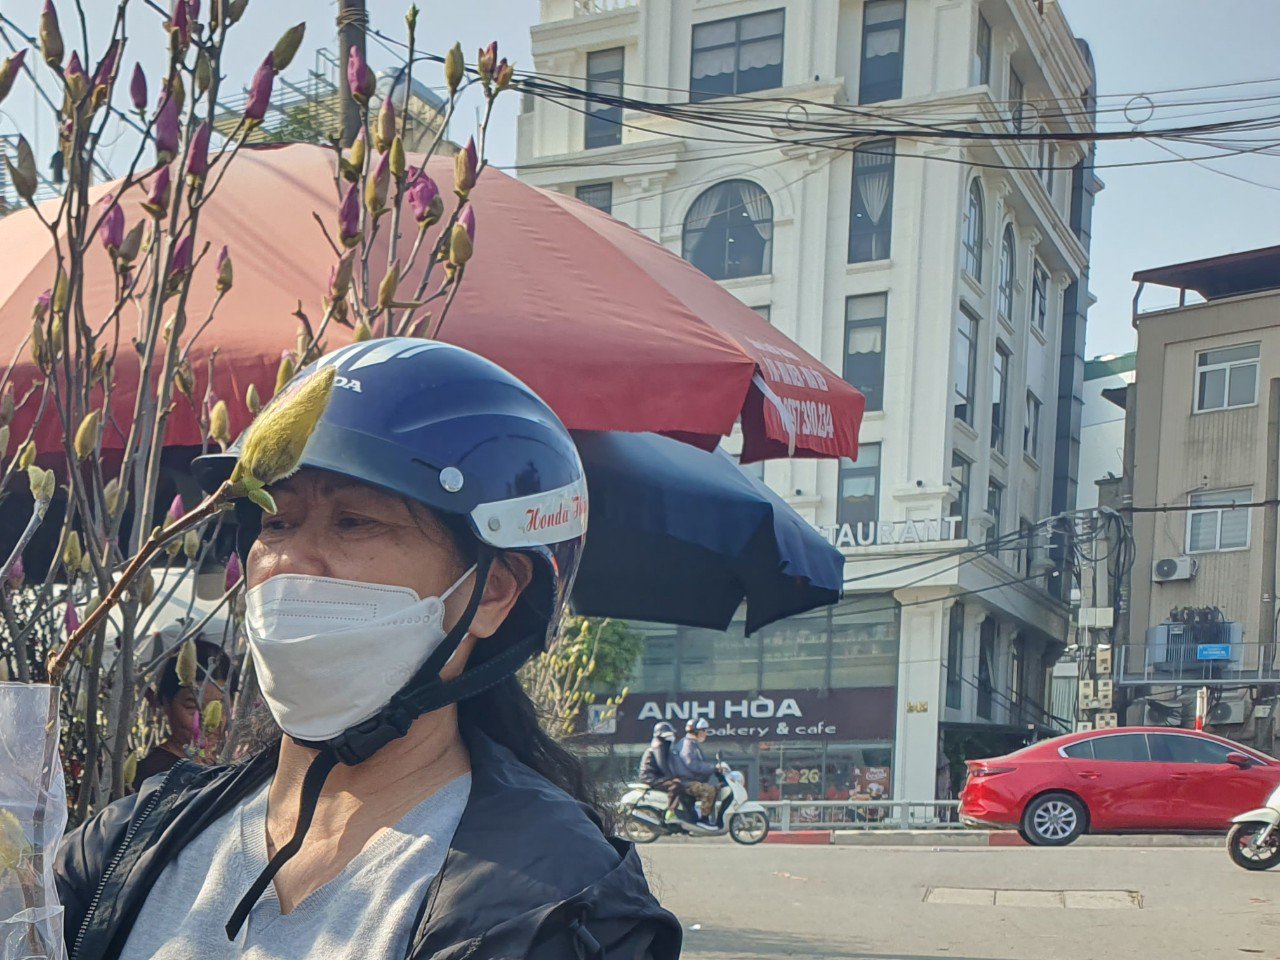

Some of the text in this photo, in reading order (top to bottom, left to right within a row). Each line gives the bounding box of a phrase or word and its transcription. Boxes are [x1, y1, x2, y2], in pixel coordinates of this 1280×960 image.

[524, 503, 569, 532] Honda
[638, 695, 803, 721] ANH HÒA
[776, 722, 789, 735] &
